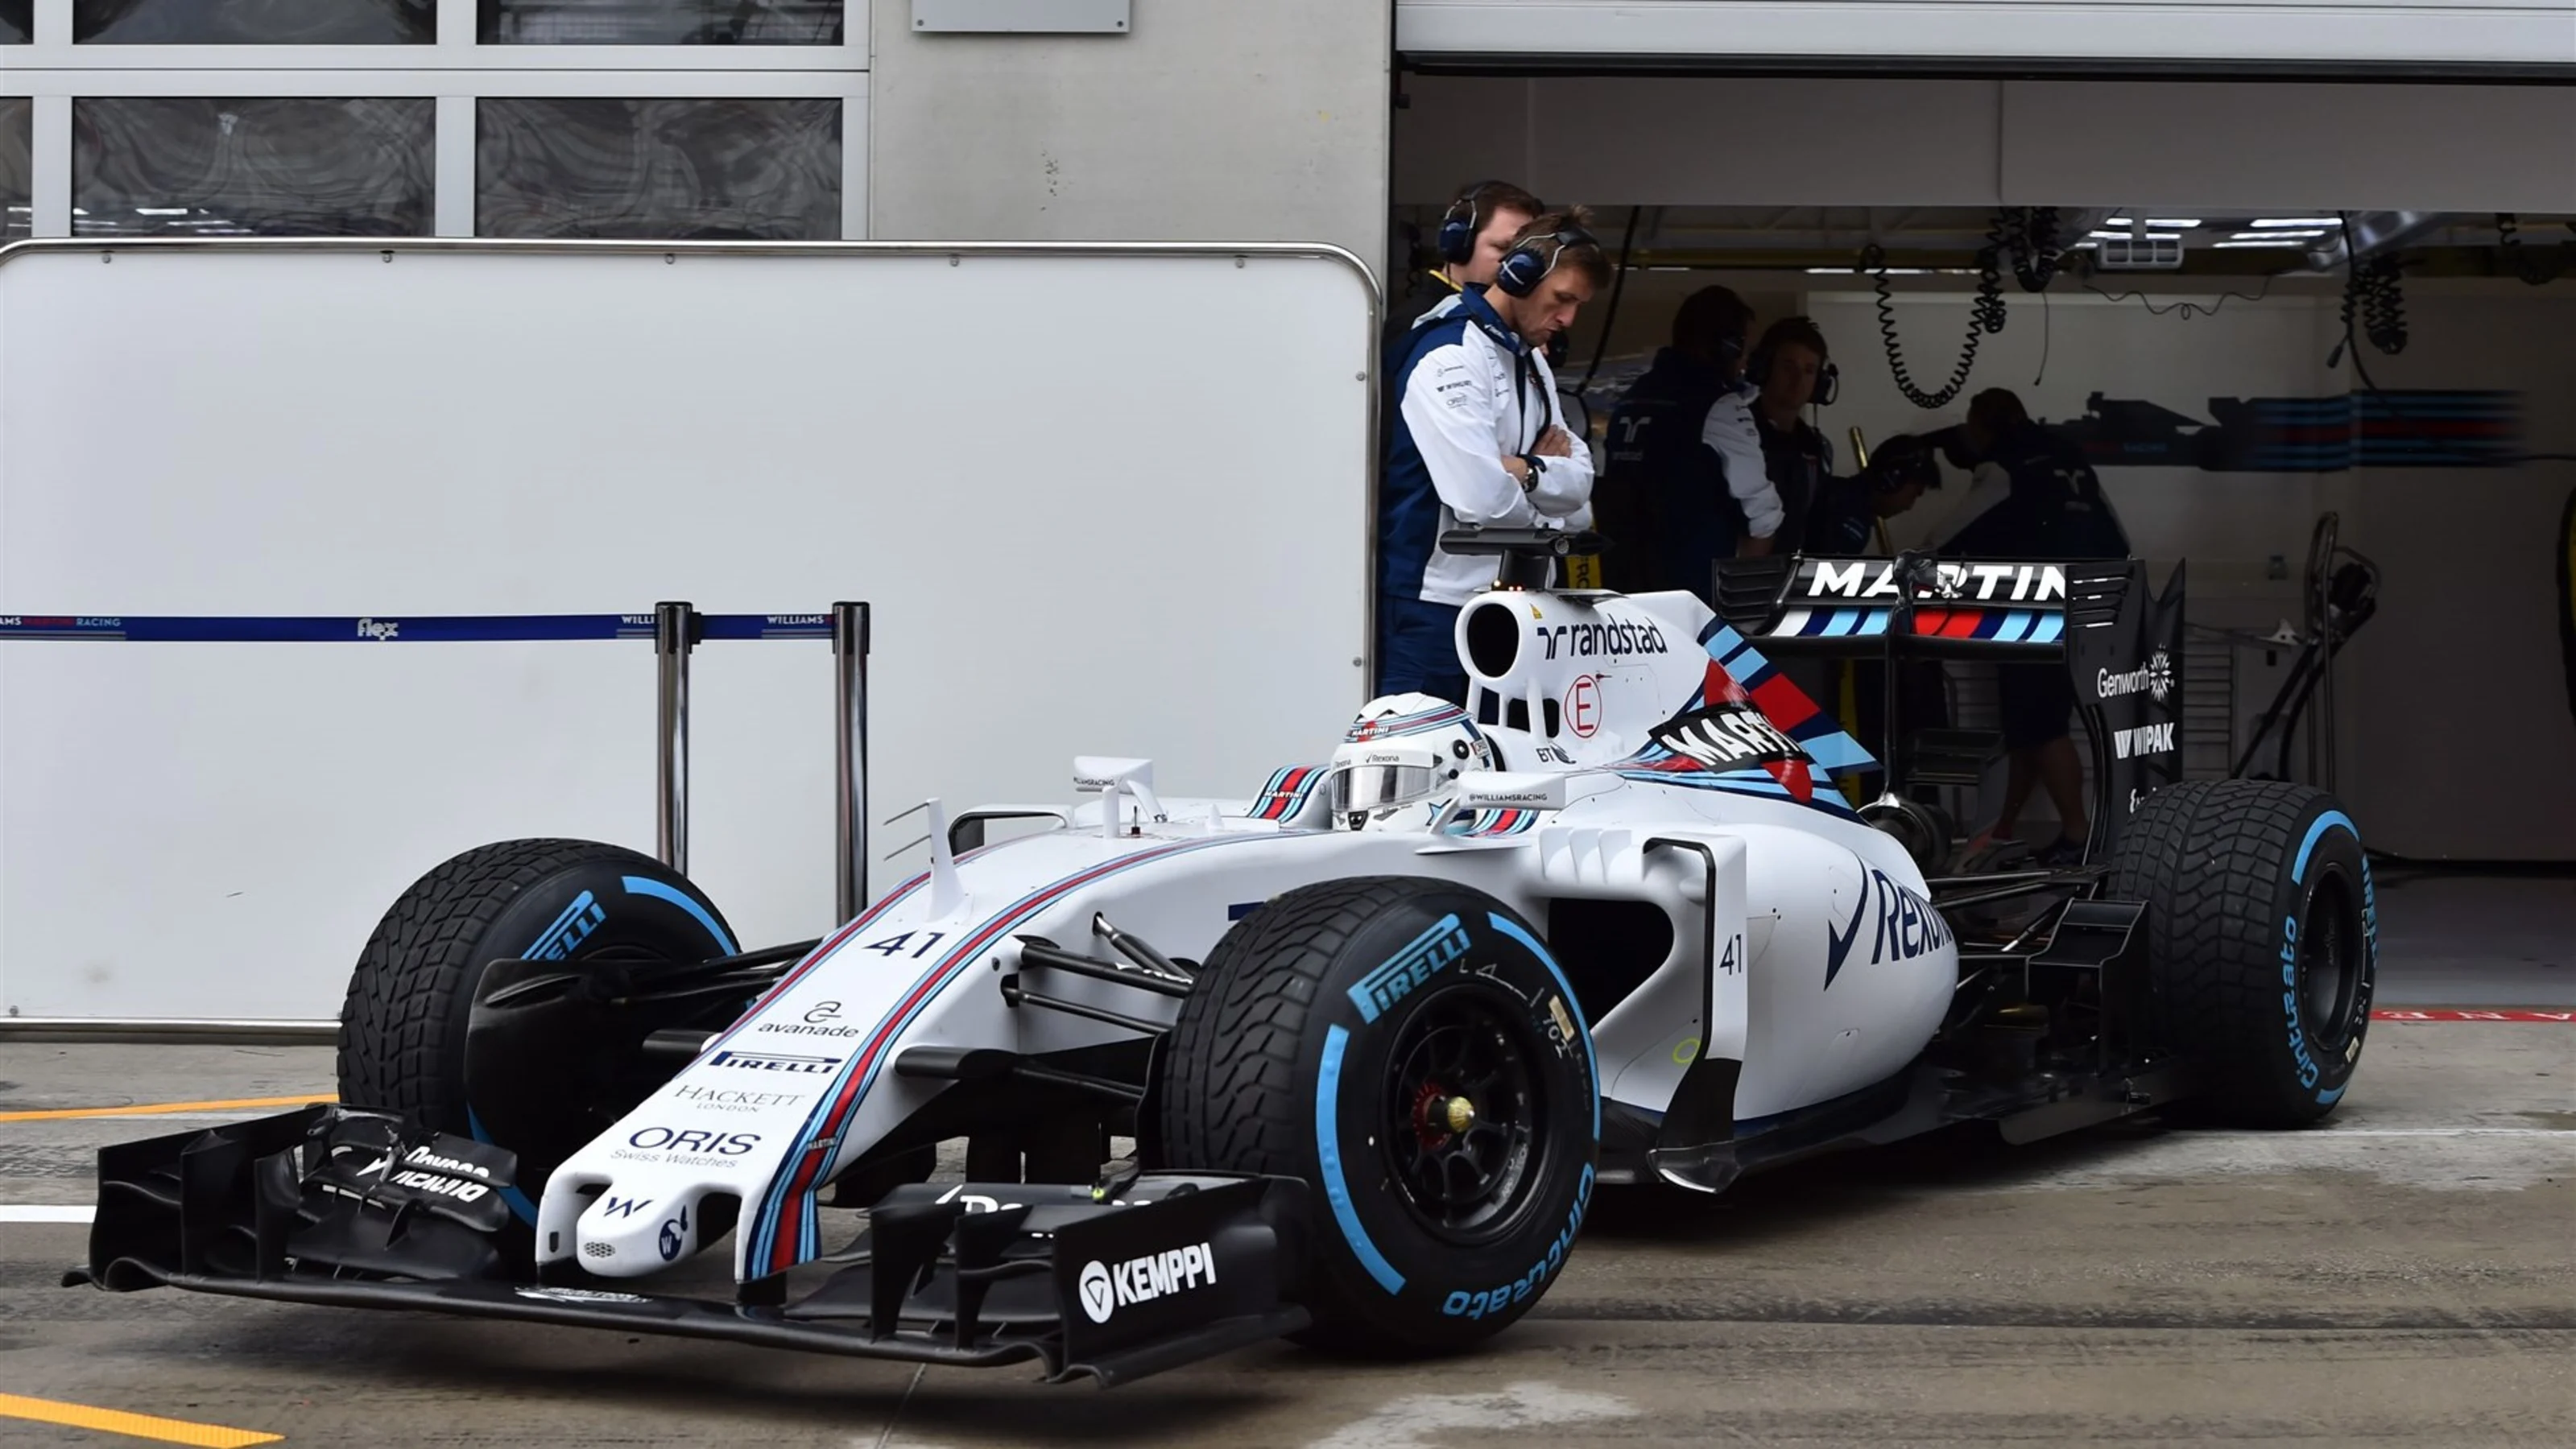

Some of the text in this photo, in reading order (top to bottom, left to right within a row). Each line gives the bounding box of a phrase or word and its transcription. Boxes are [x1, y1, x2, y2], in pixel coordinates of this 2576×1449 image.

[76, 618, 121, 626] RACING
[358, 617, 398, 640] flex
[767, 615, 824, 625] WILLIAMS
[1570, 613, 1668, 657] randstad
[2098, 662, 2149, 698] Genworth
[1576, 682, 1594, 730] E
[1350, 726, 1389, 737] MARTINI
[2134, 723, 2174, 757] WIPAK
[1263, 791, 1304, 799] MARTINI
[1470, 793, 1548, 802] @WILLIAMSRACING
[862, 930, 946, 959] 41
[1720, 934, 1742, 976] 41
[1346, 913, 1472, 1025] PIRELLI
[759, 1023, 859, 1038] avanade
[708, 1051, 842, 1074] PIRELLI
[674, 1085, 806, 1107] HACKETT
[696, 1103, 760, 1113] LONDON
[629, 1127, 761, 1156] ORIS
[610, 1149, 738, 1169] Swiss Watches
[1113, 1241, 1217, 1307] KEMPPI
